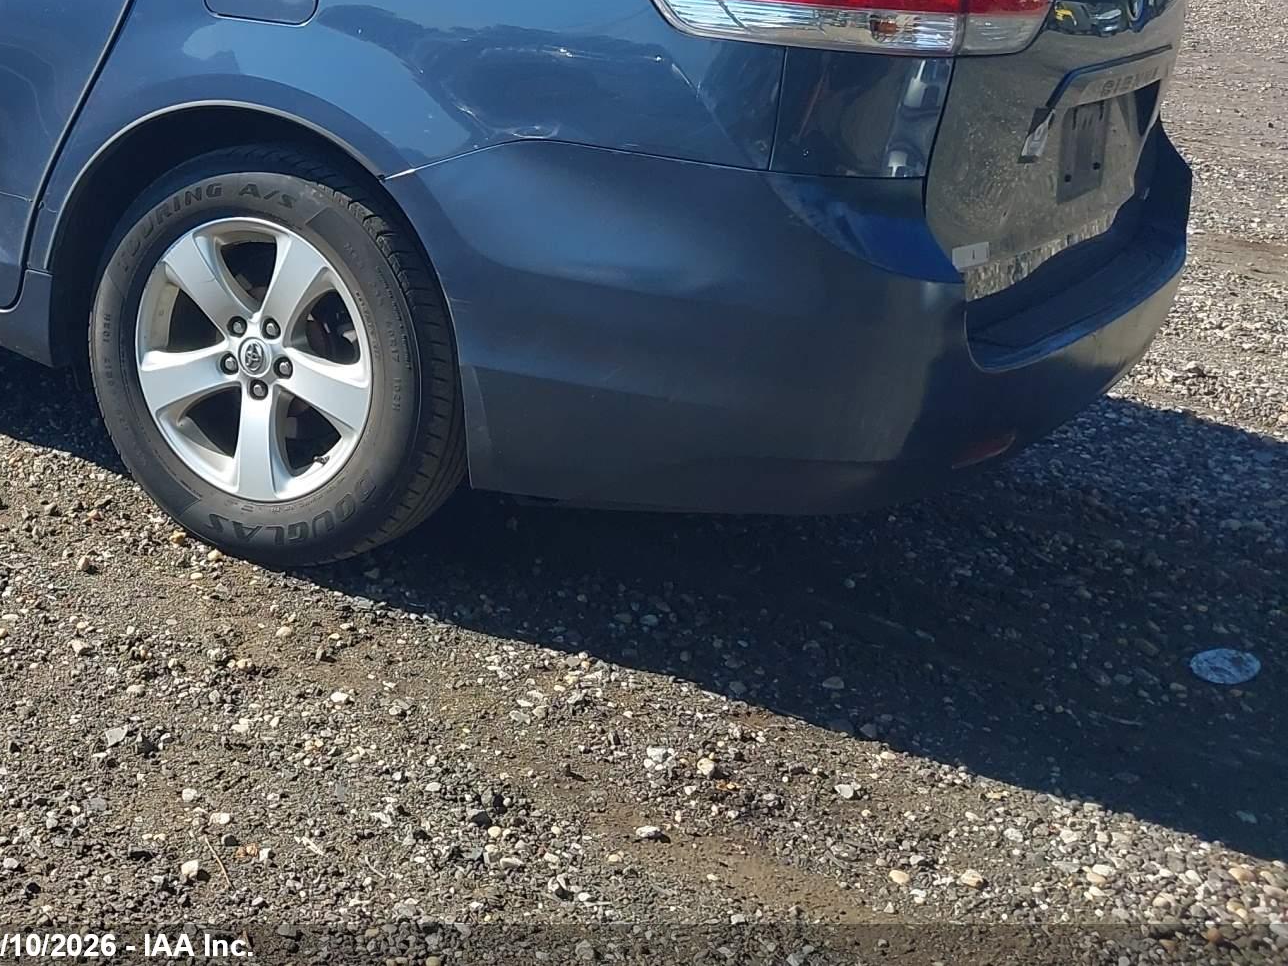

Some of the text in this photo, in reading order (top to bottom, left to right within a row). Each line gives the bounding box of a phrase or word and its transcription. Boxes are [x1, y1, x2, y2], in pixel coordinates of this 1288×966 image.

[117, 182, 298, 273] TOURING A/S
[203, 468, 378, 547] DOUGLAS
